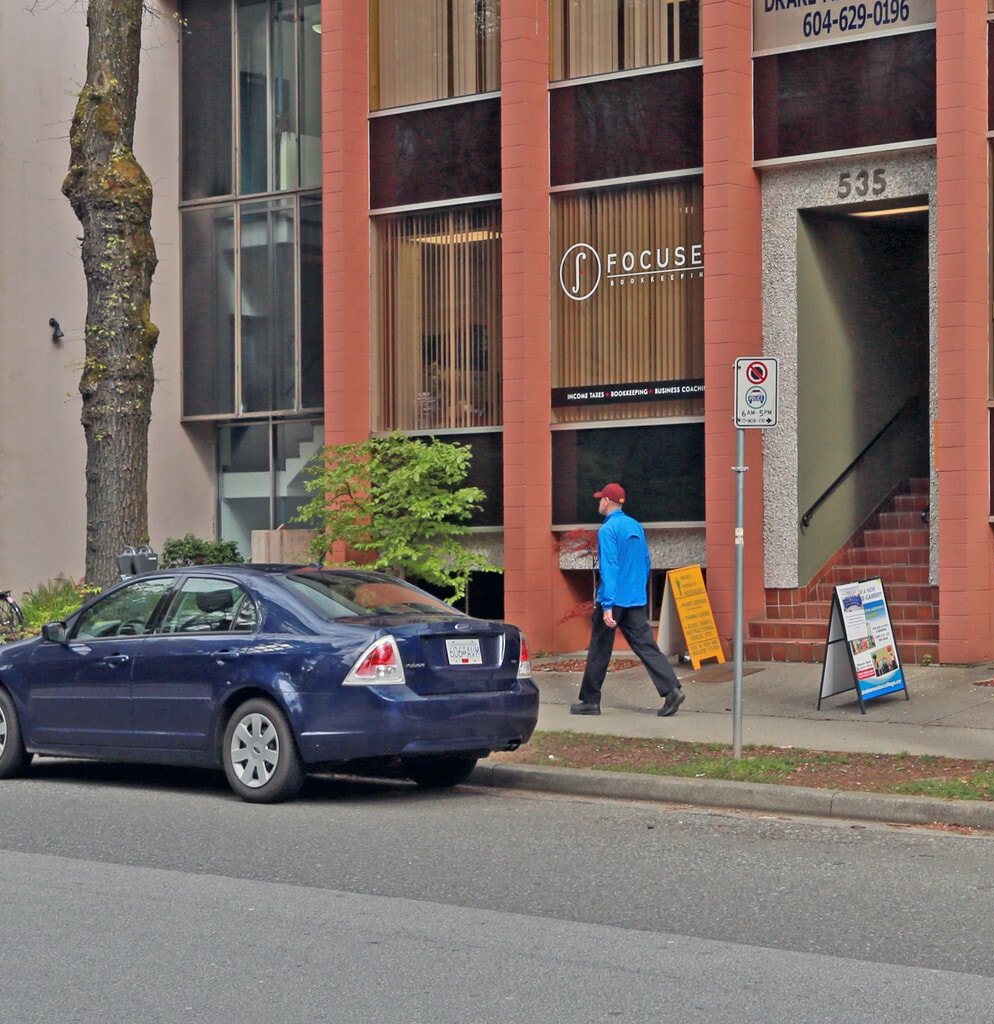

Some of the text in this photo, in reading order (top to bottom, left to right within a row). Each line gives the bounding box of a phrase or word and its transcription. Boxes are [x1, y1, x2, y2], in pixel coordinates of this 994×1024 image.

[837, 168, 887, 198] 535
[607, 244, 702, 273] FOCUSE
[567, 392, 588, 400] INCOME
[589, 391, 604, 399] TAXES
[610, 388, 648, 397] BOOKKEEPING
[654, 386, 680, 395] BUSINESS
